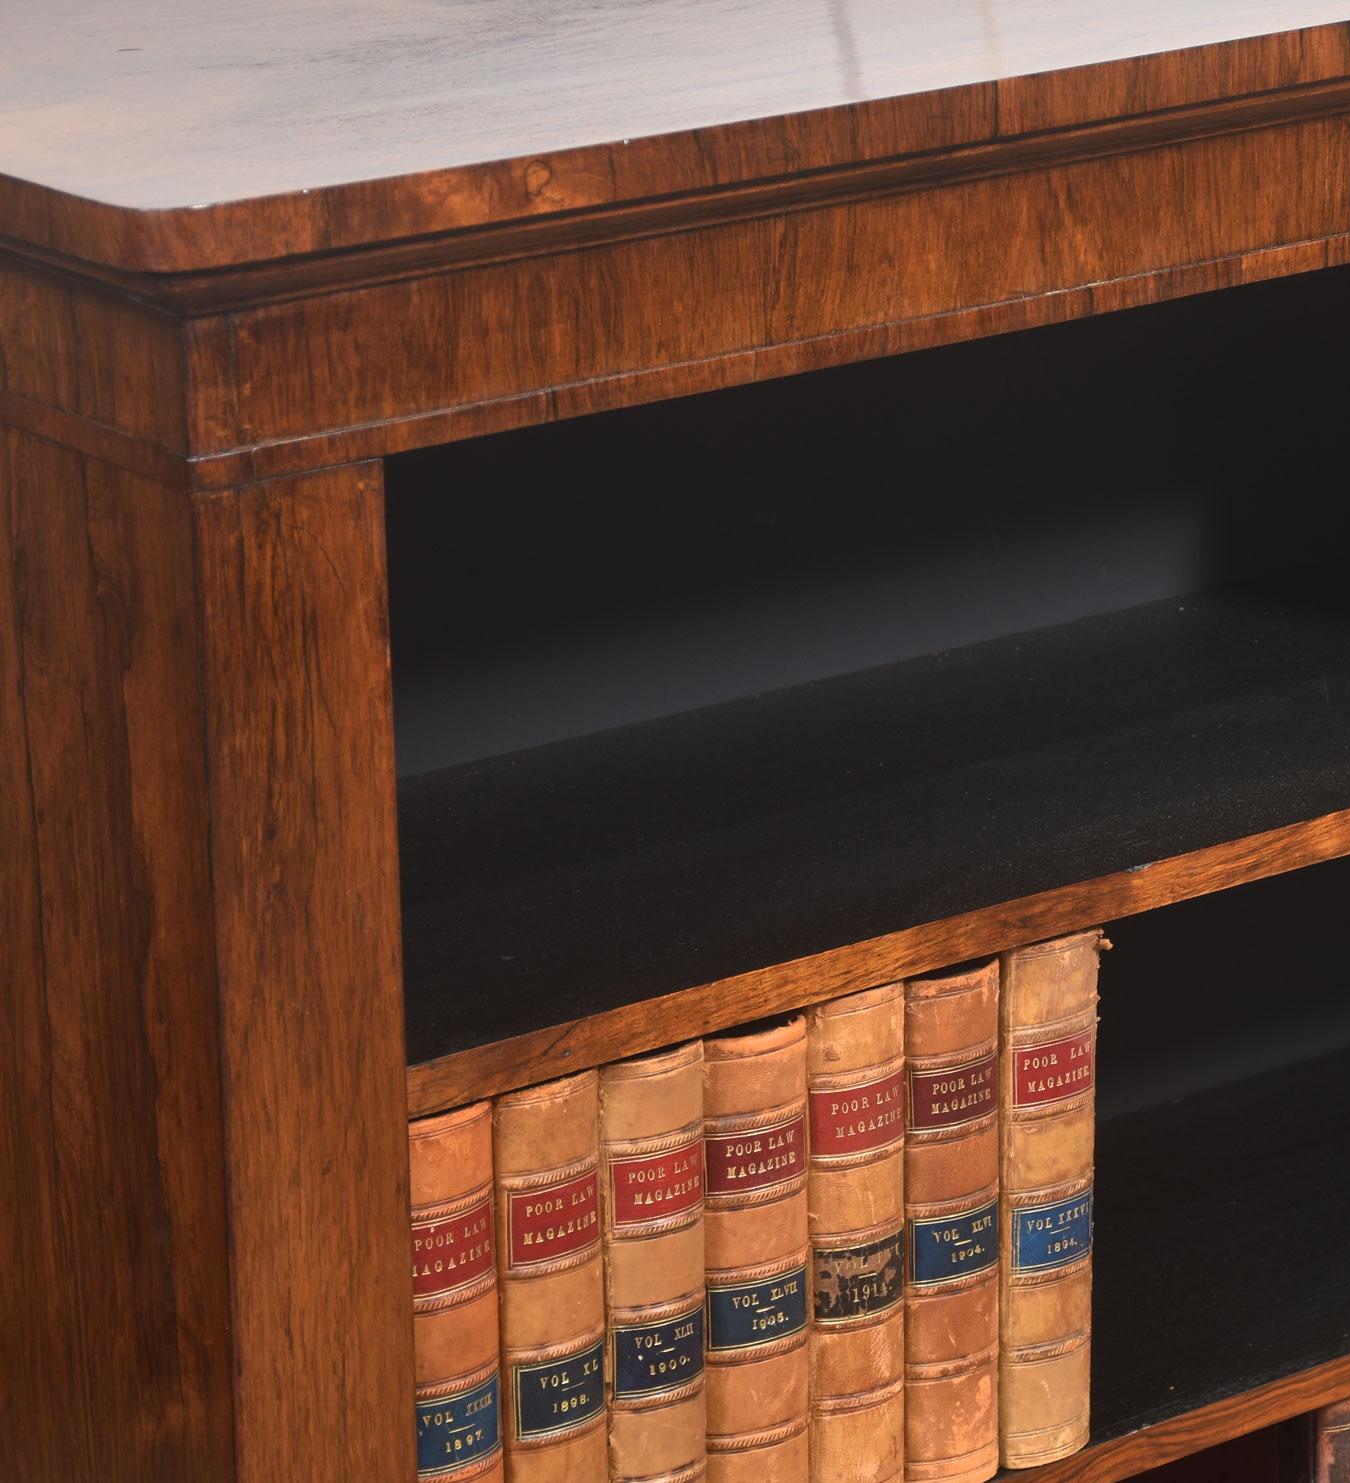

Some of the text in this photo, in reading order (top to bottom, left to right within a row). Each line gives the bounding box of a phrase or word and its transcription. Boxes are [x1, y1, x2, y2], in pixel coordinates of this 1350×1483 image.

[1023, 1040, 1092, 1071] POOR LAW
[932, 1066, 993, 1095] POOR LAW
[1027, 1065, 1090, 1093] MAGAZINE
[831, 1085, 900, 1115] POOR LAW
[931, 1088, 992, 1115] MAGAZINE
[835, 1108, 901, 1139] MAGAZINE
[726, 1129, 796, 1158] POOR LAW
[628, 1154, 698, 1185] POOR LAW
[726, 1151, 797, 1179] MAGAZINE
[525, 1185, 595, 1218] POOR LAW
[632, 1175, 700, 1206] MAGAZINE
[522, 1210, 597, 1246] MAGAZINE
[933, 1215, 993, 1244] VOL XLVI
[1026, 1202, 1090, 1234] VOL XXXVI
[414, 1216, 488, 1252] POOR LAW
[732, 1280, 799, 1310] VOL XLVII
[635, 1323, 695, 1349] VOL XLII
[539, 1359, 599, 1390] VOL XL
[422, 1410, 454, 1428] VOL
